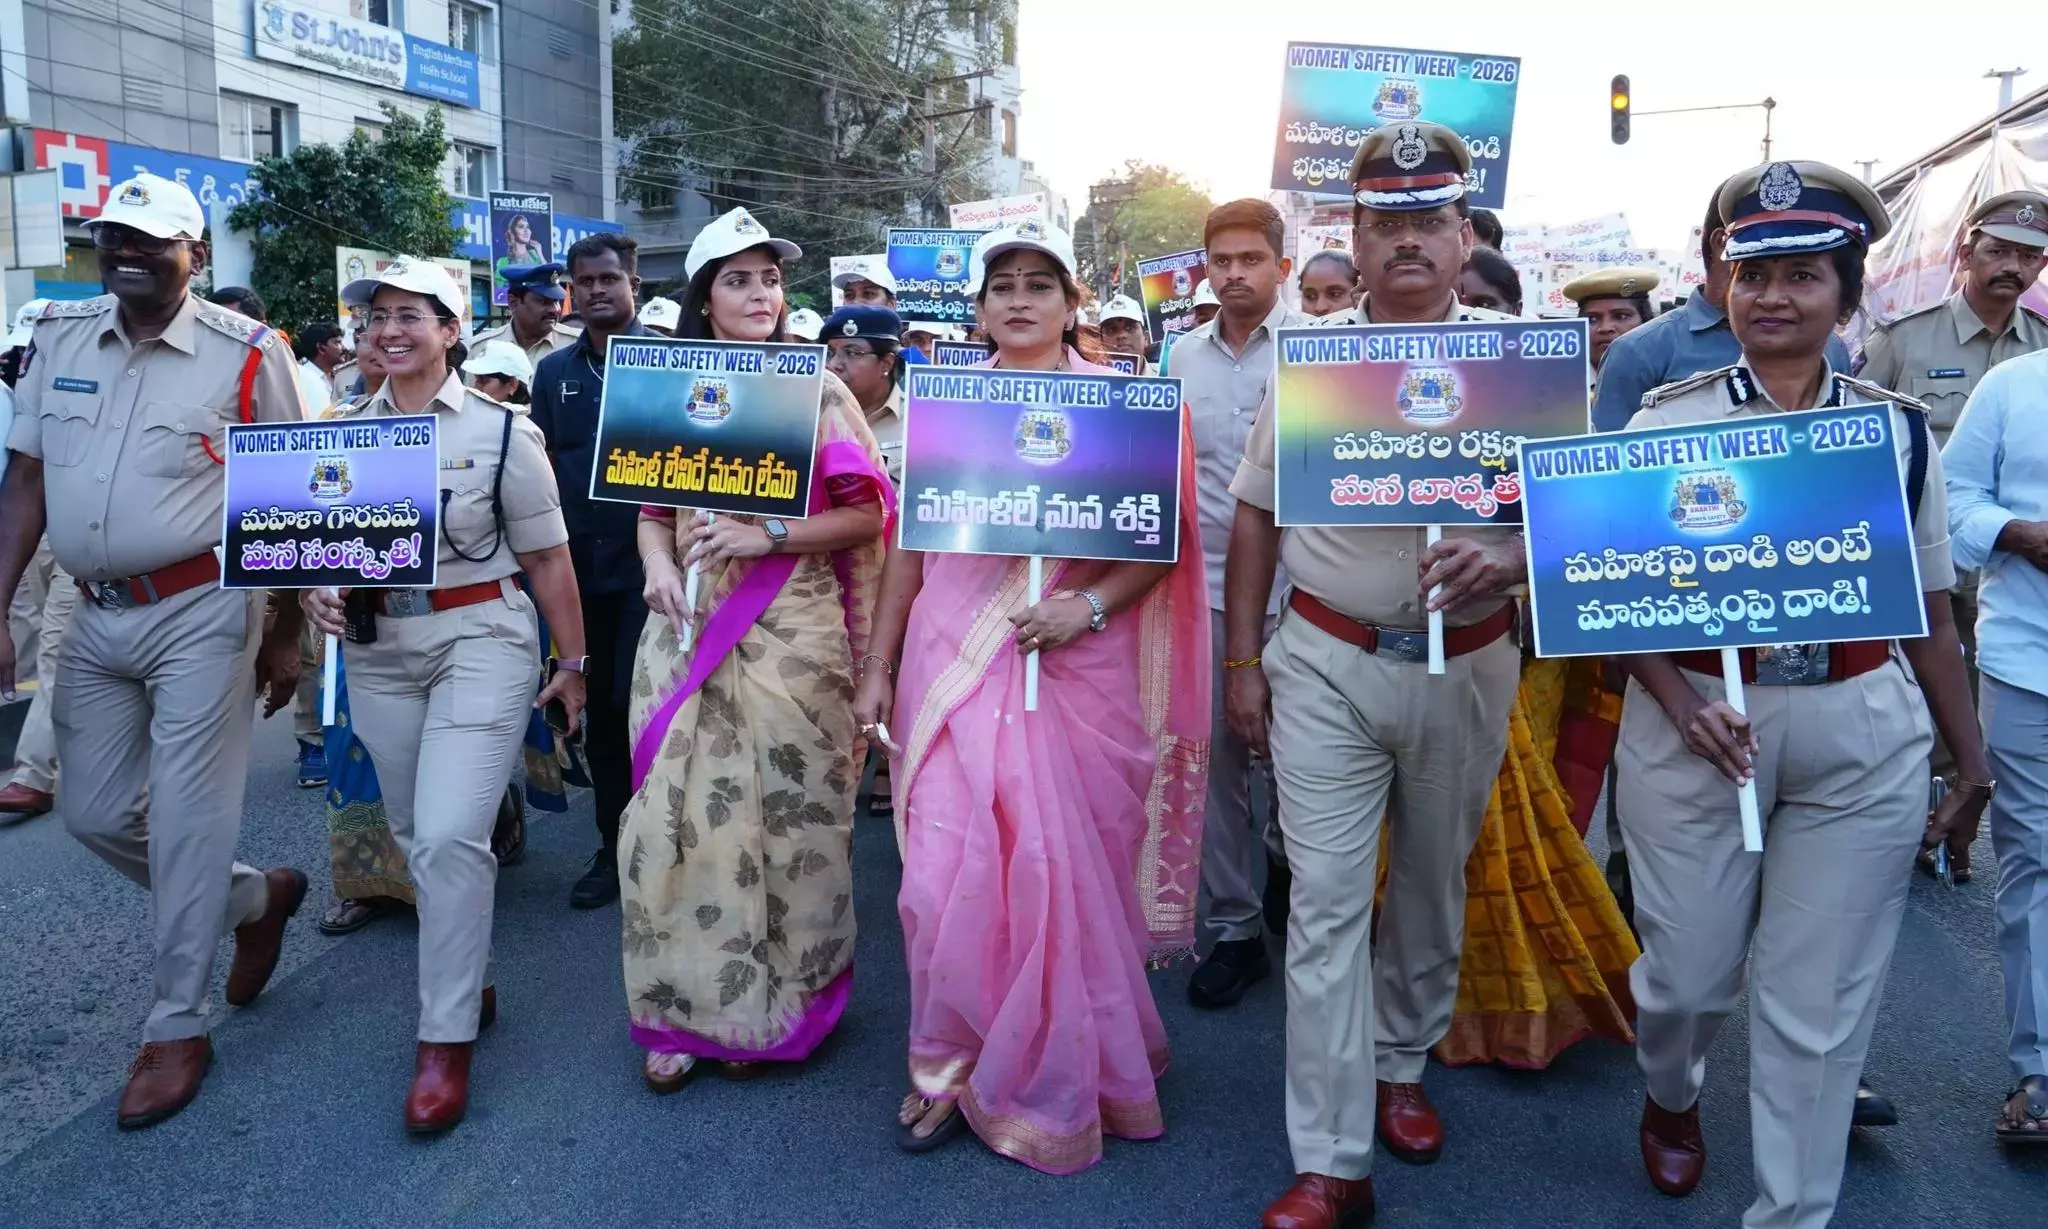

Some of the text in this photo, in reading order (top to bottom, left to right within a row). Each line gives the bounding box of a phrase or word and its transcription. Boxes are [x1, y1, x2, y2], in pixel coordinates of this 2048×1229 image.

[1291, 48, 1349, 69] WOMEN
[1354, 52, 1410, 74] SAFETY
[1414, 56, 1456, 77] WEEK
[1472, 61, 1515, 82] 2026
[891, 232, 923, 244] WOMEN
[926, 232, 956, 245] SAFETY
[895, 279, 942, 298] మహిళపై
[615, 346, 667, 368] WOMEN
[671, 349, 721, 371] SAFETY
[725, 352, 762, 373] WEEK
[777, 354, 816, 375] 2026
[1286, 337, 1361, 363] WOMEN
[1368, 334, 1439, 361] SAFETY
[1445, 333, 1502, 359] WEEK
[1522, 331, 1578, 356] 2026
[915, 375, 983, 400] WOMEN
[990, 379, 1056, 403] SAFETY
[1059, 382, 1108, 405] WEEK
[1127, 385, 1175, 408] 2026
[234, 432, 286, 454] WOMEN
[291, 429, 338, 452] SAFETY
[343, 427, 380, 449] WEEK
[393, 425, 430, 447] 2026
[1333, 431, 1451, 460] మహిళల
[1532, 446, 1620, 478] WOMEN
[1628, 436, 1711, 468] SAFETY
[1719, 427, 1785, 459] WEEK
[1812, 417, 1882, 449] 2026
[606, 445, 798, 499] మహిళ లేనిదే మనం లేము
[1330, 474, 1404, 506] మన
[241, 497, 420, 531] మహిళా గౌరవమే
[916, 485, 1161, 545] మహిళలే మన శక్తి
[241, 532, 422, 579] మన సంస్కృతి!
[1564, 520, 1872, 588] మహిళపై దాడి అంటే
[1577, 575, 1872, 637] మానవత్వంపై దాడి!
